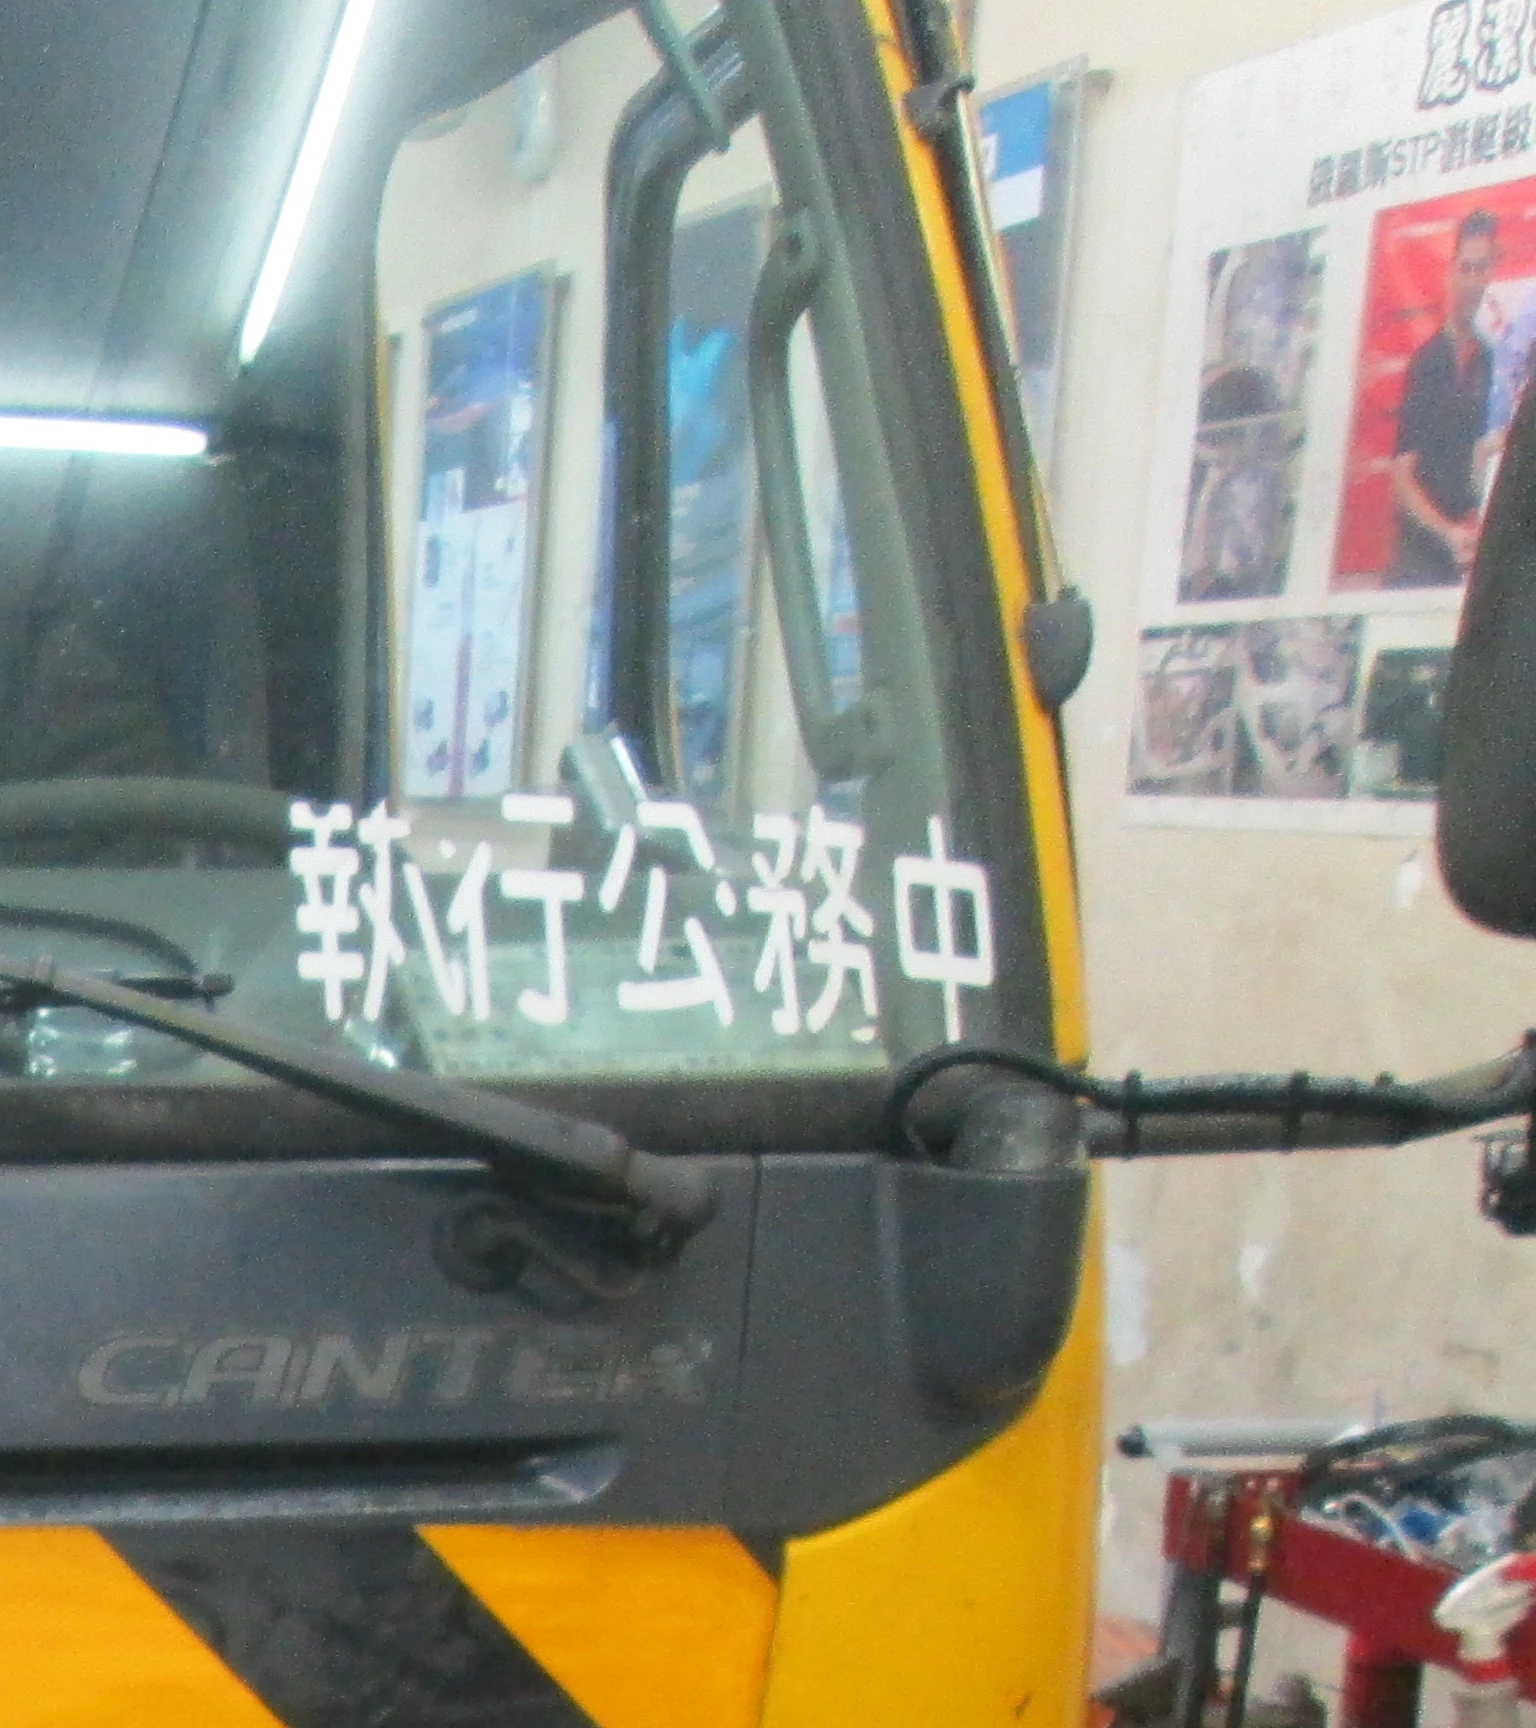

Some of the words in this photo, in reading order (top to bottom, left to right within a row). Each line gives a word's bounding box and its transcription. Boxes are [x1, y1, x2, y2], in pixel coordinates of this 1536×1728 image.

[289, 794, 995, 1043] 執行公務中
[77, 1329, 714, 1404] CANTER
